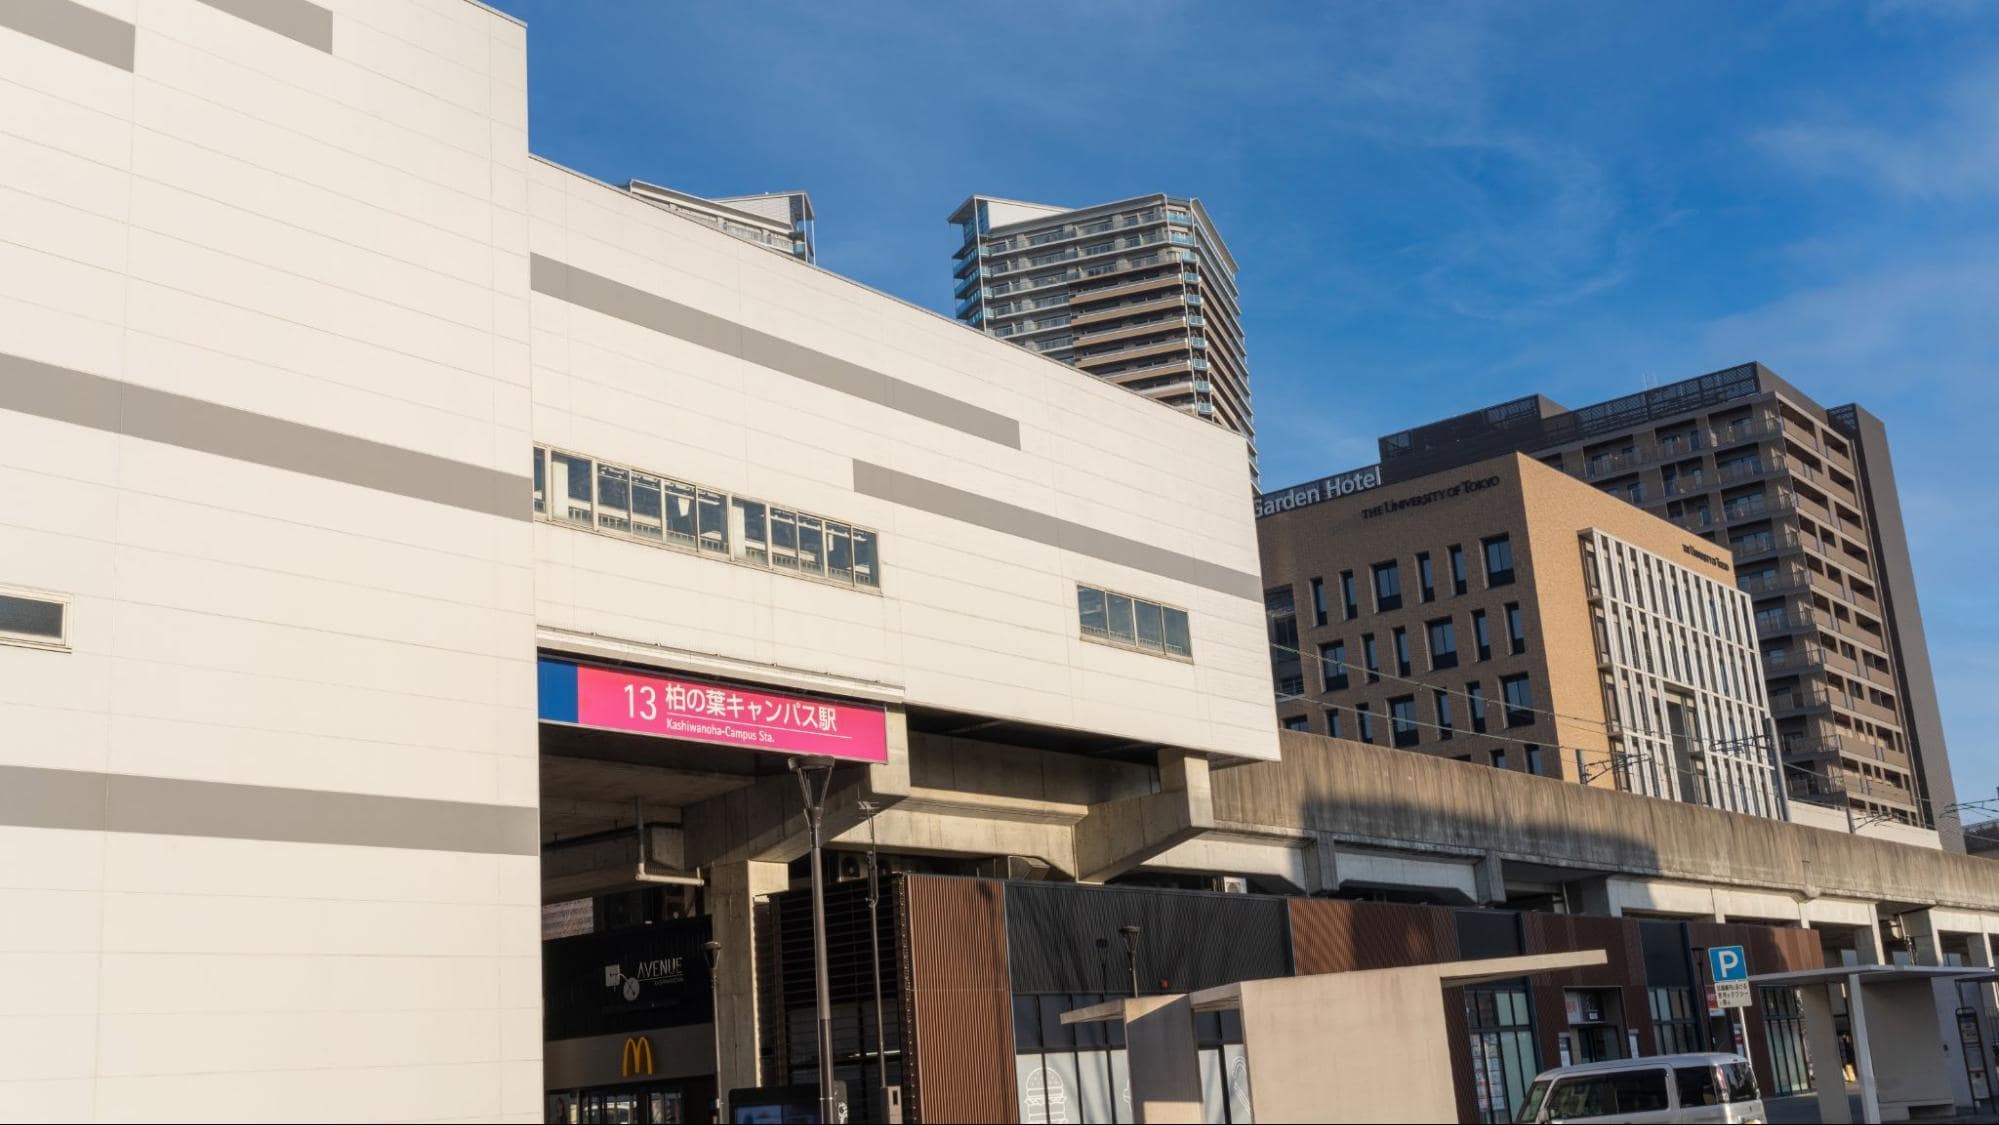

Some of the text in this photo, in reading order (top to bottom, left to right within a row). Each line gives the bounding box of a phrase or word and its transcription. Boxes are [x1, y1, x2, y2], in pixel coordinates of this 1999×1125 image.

[1326, 465, 1382, 499] Hotel
[1361, 475, 1500, 519] THE UNIVERSITY OF TOKYO
[623, 684, 657, 721] 13
[665, 683, 838, 733] 柏の葉キャンパス駅
[666, 718, 775, 743] Kashiwanoha-Campus Sta.
[637, 957, 684, 978] AVENUE
[1718, 950, 1738, 978] P
